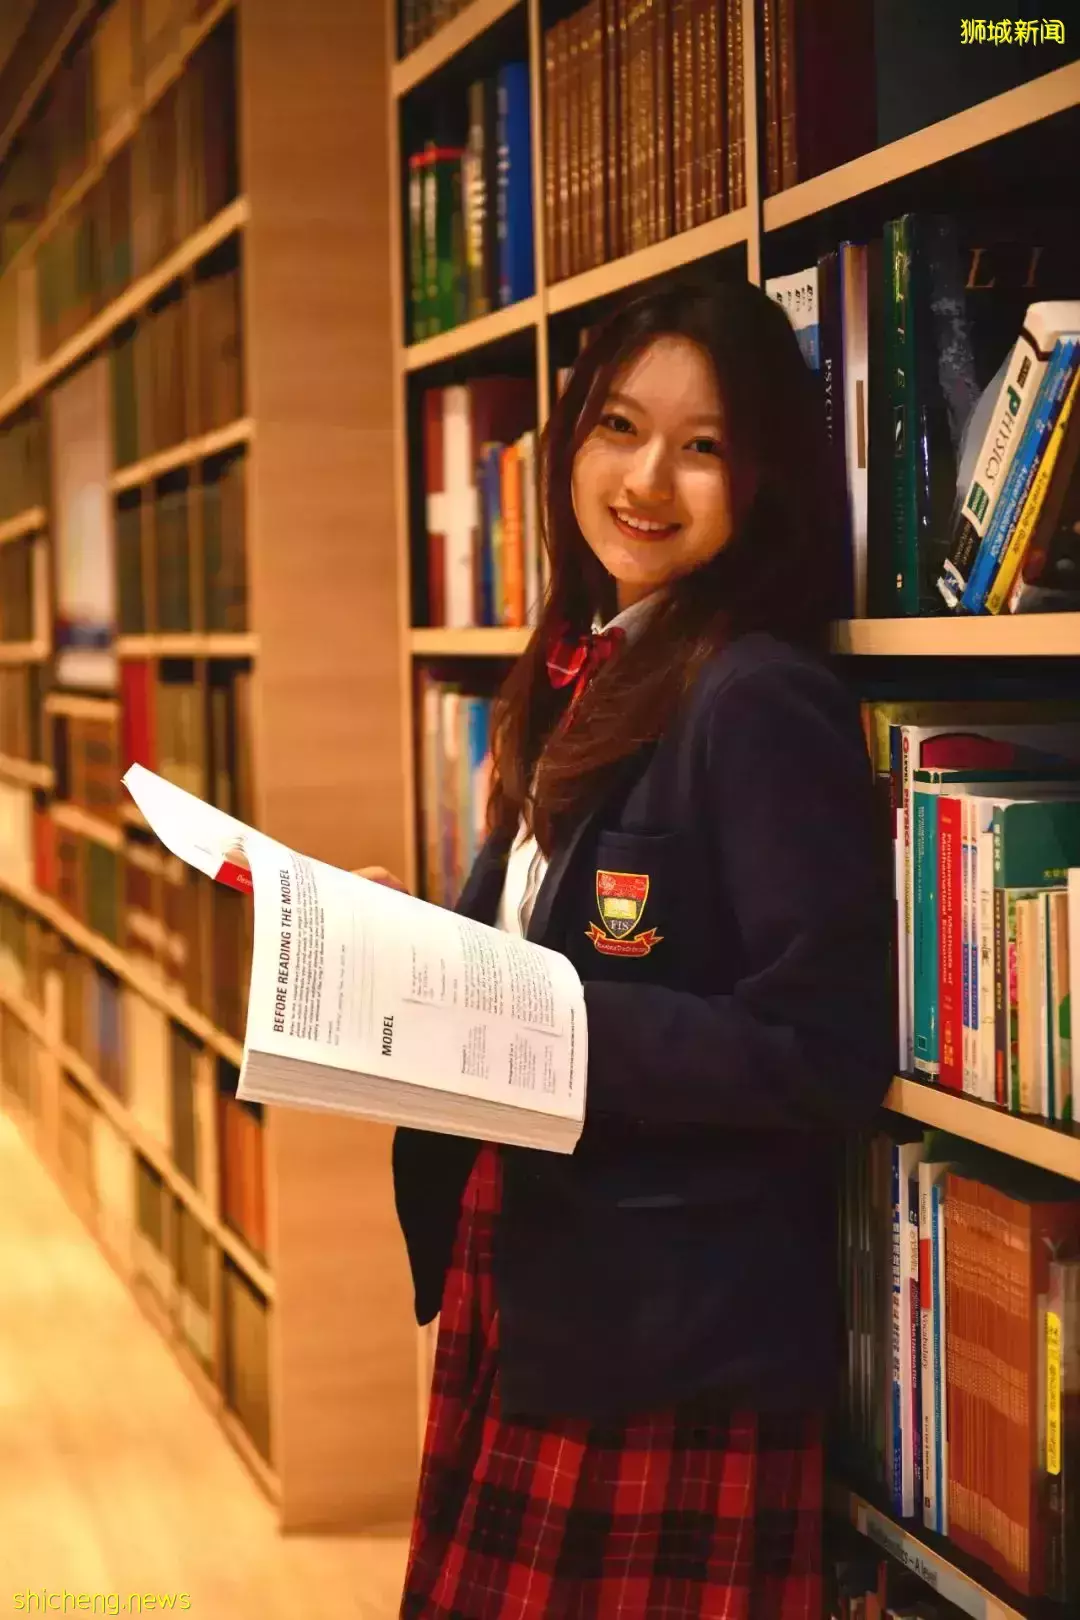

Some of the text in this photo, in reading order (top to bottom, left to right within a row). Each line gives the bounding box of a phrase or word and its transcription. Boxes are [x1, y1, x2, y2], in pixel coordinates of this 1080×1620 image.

[985, 385, 1021, 484] PHYSICS
[273, 869, 292, 1033] BEFORE READING THE MODEL
[610, 919, 630, 931] FIS
[381, 1015, 394, 1057] MODEL
